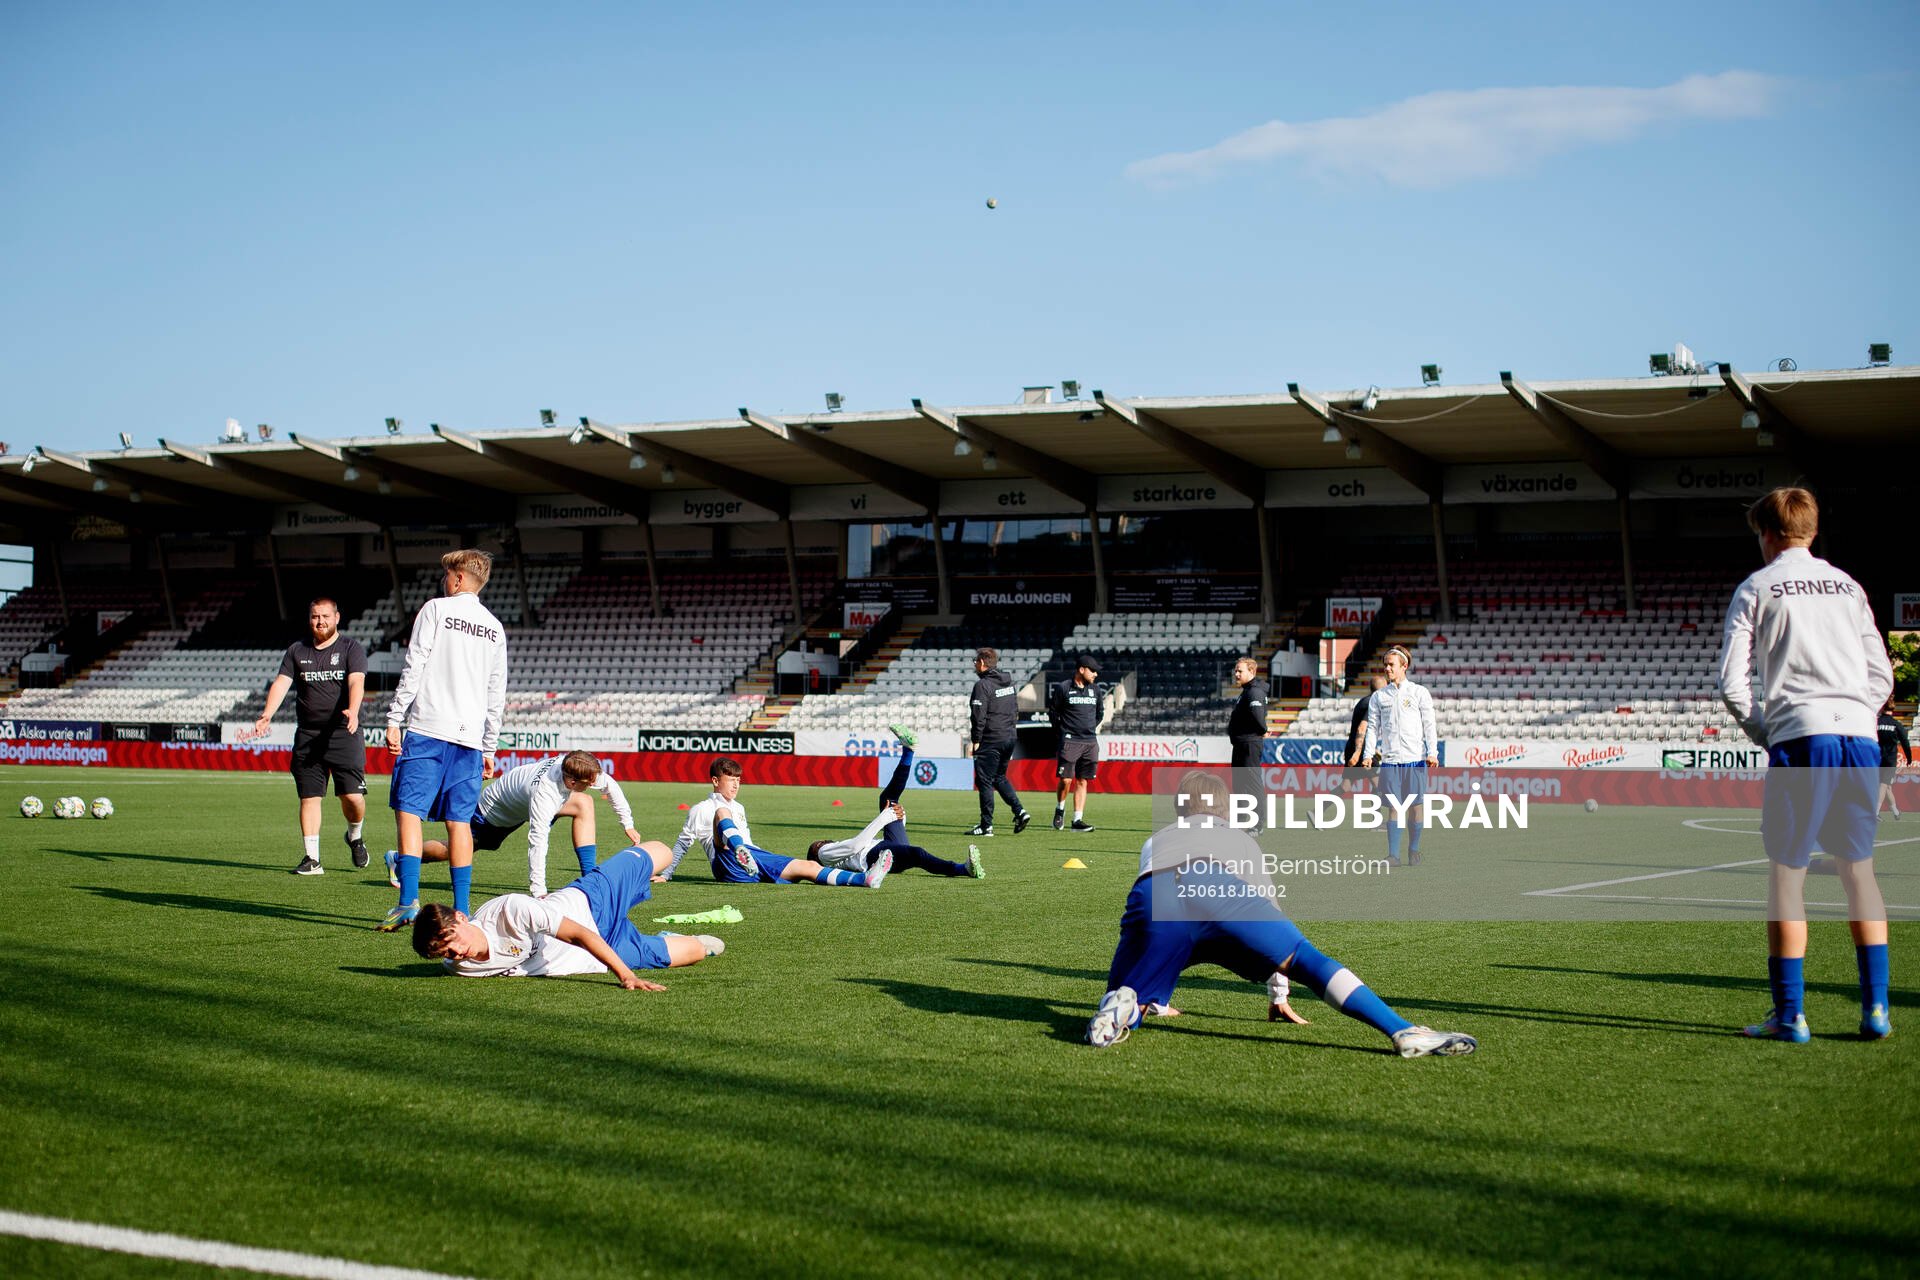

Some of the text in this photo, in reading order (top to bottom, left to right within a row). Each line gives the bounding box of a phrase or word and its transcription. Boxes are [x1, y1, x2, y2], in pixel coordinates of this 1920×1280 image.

[1481, 474, 1577, 492] växande
[1677, 466, 1765, 489] Örebro!
[1133, 484, 1217, 503] starkare
[1328, 480, 1365, 497] och
[851, 494, 866, 510] vi
[998, 492, 1026, 506] ett
[530, 504, 624, 519] Tillsammans
[684, 499, 743, 519] bygger
[970, 593, 1072, 605] EYRALOUNGEN
[445, 617, 497, 642] SERNEKE
[19, 723, 46, 739] Älska
[48, 728, 74, 741] varje
[76, 727, 92, 740] mil
[517, 733, 559, 749] FRONT
[640, 734, 793, 753] NORDICWELLNESS
[1107, 741, 1176, 757] BEHRN
[0, 742, 108, 764] Boglundsängen
[1465, 744, 1527, 768] Radiator
[1563, 745, 1628, 768] Radiator
[1698, 751, 1761, 770] FRONT
